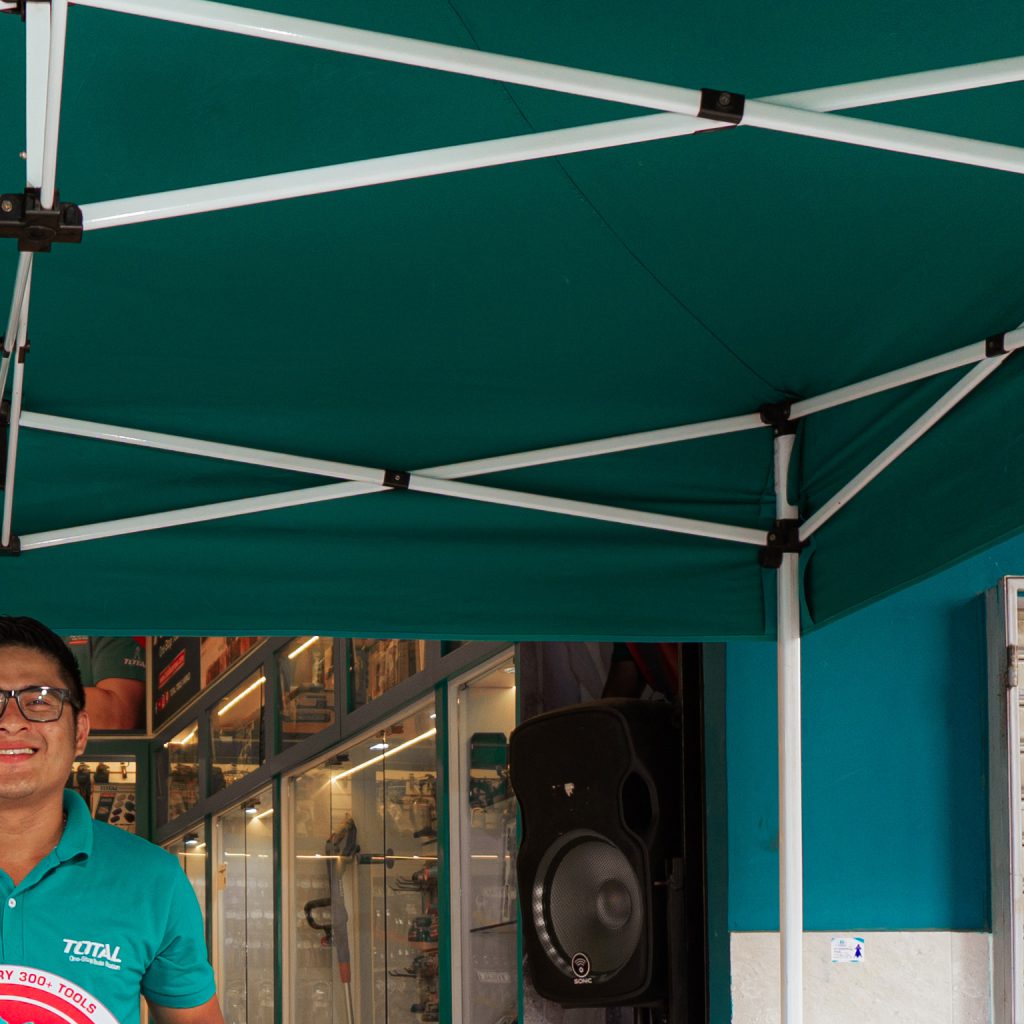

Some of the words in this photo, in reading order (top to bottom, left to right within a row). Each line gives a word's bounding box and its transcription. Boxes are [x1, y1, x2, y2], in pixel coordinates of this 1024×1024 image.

[63, 938, 122, 963] TOTAL
[19, 971, 53, 989] 300+
[57, 983, 97, 1015] TOOLS
